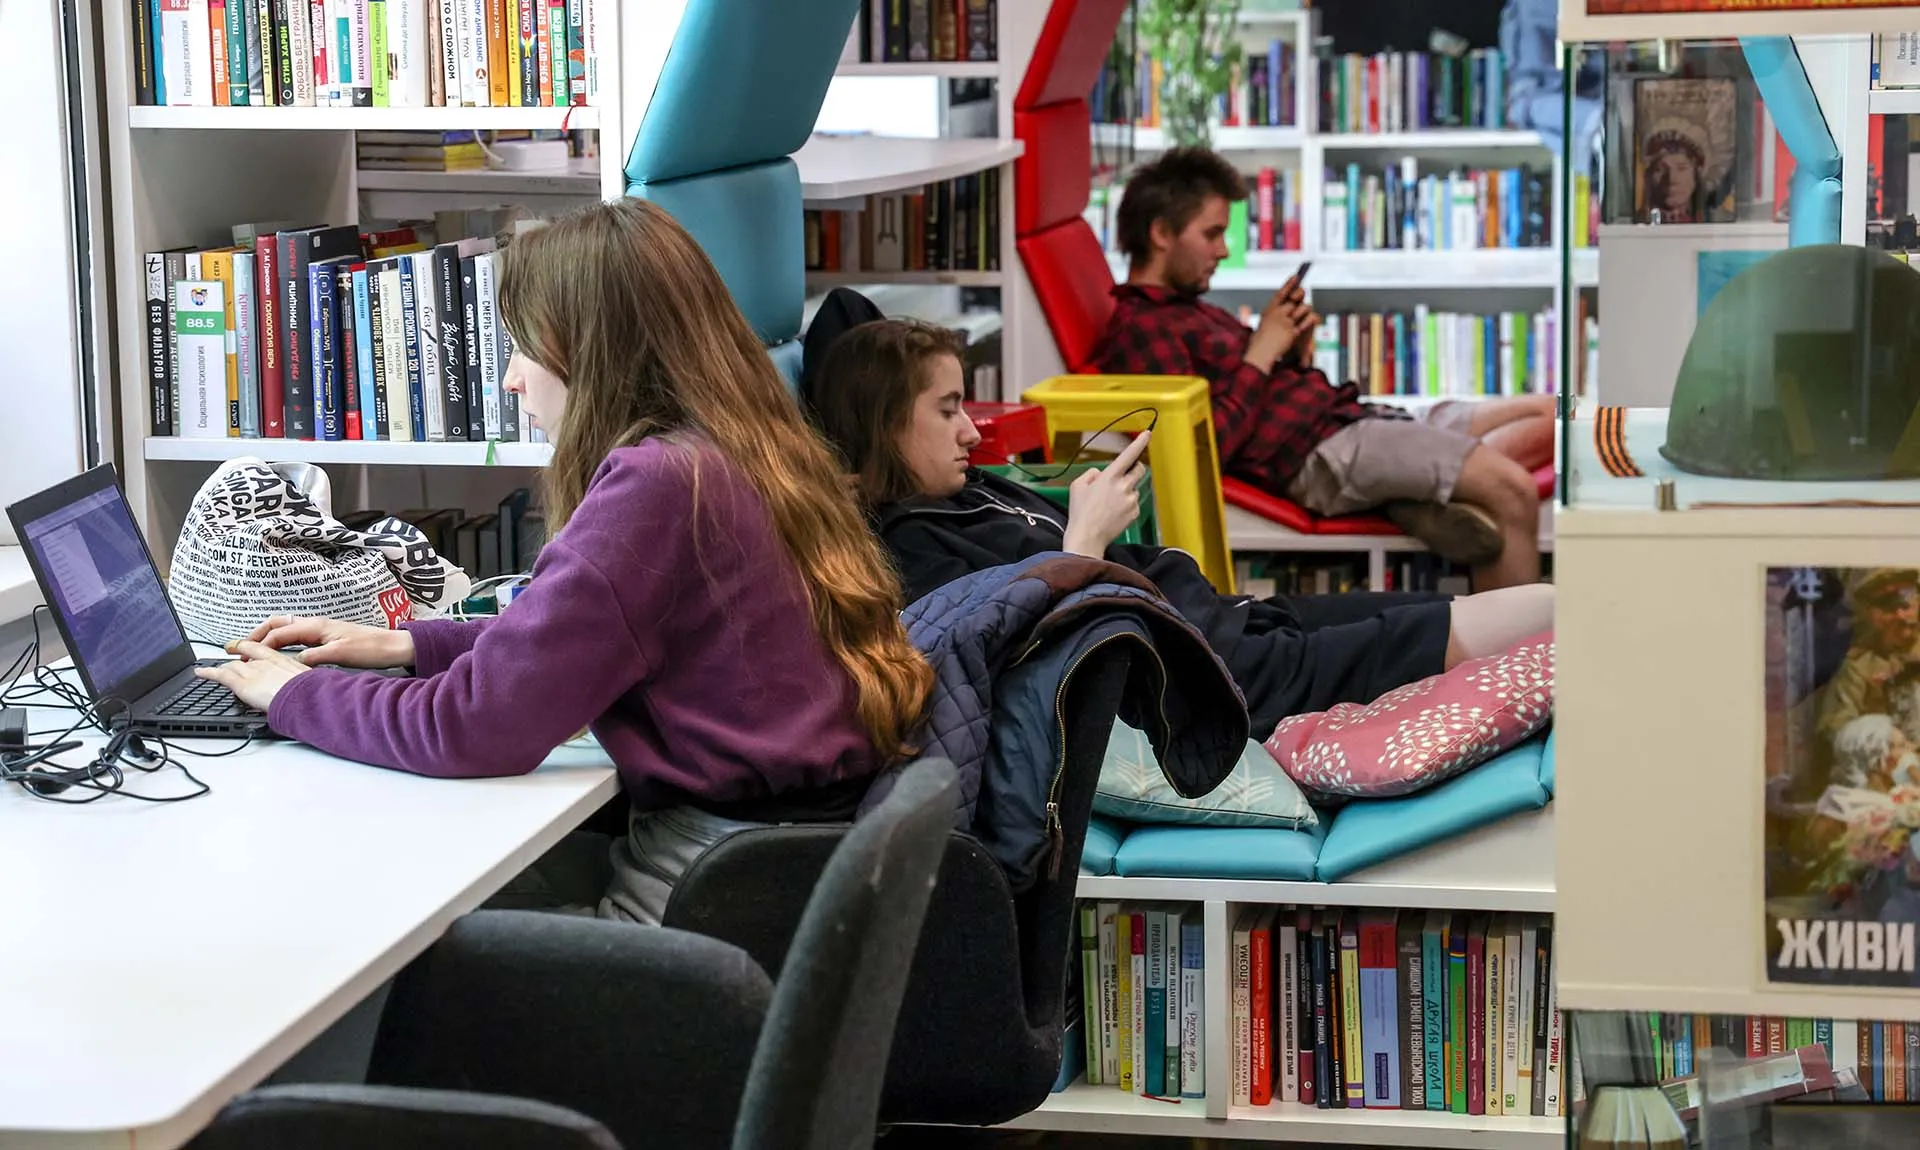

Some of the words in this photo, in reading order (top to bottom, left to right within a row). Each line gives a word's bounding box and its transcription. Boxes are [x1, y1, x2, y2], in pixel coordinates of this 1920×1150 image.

[261, 15, 270, 55] КОТОРОЙ
[475, 17, 483, 36] ДНЮ
[522, 8, 531, 32] СИЛА
[181, 20, 191, 60] психология
[280, 26, 290, 56] ХАРВИ
[294, 38, 303, 56] БЕЗ
[355, 27, 365, 81] психология
[401, 39, 409, 70] Симона
[446, 27, 455, 80] СЛОЖНОМ
[262, 58, 270, 76] НЕТ
[282, 57, 291, 84] СТИВ
[296, 59, 306, 99] ЛЮБОВЬ
[443, 258, 451, 280] МАРИЯ
[288, 280, 298, 329] ПРИНЦИПЫ
[402, 280, 413, 308] РЕШИЛ
[151, 305, 163, 325] БЕЗ
[186, 317, 215, 329] 88.5
[265, 300, 273, 348] ПСИХОЛОГИЯ
[373, 307, 383, 340] ЗВОНИТЬ
[404, 309, 416, 346] ПРОЖИТЬ
[423, 305, 436, 328] без
[466, 303, 475, 332] ИДЕЮ
[482, 300, 492, 329] СМЕРТЬ
[153, 327, 164, 379] ФИЛЬТРОВ
[290, 330, 299, 361] ДАЛИО
[375, 340, 384, 357] МНЕ
[425, 343, 439, 377] обид
[467, 332, 479, 366] ПОДАЙ
[484, 332, 494, 383] ЭКСПЕРТИЗЫ
[502, 333, 511, 359] ПРОС
[196, 345, 207, 386] психология
[376, 358, 385, 387] ХВАТИТ
[408, 358, 419, 371] 120
[197, 387, 209, 428] Социальная
[230, 551, 244, 565] ST.
[245, 569, 278, 579] MOSCOW
[281, 563, 327, 577] SHANGHAI
[242, 580, 261, 588] HONG
[283, 575, 320, 588] BANGKOK
[259, 589, 300, 597] PETERSBURG
[301, 586, 323, 595] TOKYO
[324, 583, 340, 592] NEW
[299, 594, 330, 602] FRANCISCO
[331, 590, 353, 599] MANILA
[1150, 923, 1161, 986] ПРЕПОДАВАТЕЛЬ
[1169, 945, 1177, 976] ИСТОРИЯ
[1778, 918, 1915, 972] ЖИВИ
[1240, 944, 1248, 989] НЕПОЭМА
[1409, 957, 1422, 996] СЛИШКОМ
[1103, 979, 1111, 1021] испортить
[1111, 990, 1119, 1021] первые
[1134, 974, 1142, 1017] МНОГОДЕТНОЙ
[1169, 978, 1177, 1020] ПЕДАГОГИКИ
[1316, 983, 1324, 1006] УМНАЯ
[1410, 997, 1422, 1022] ТЕМНО
[1104, 1022, 1110, 1033] не
[1426, 998, 1440, 1044] ДРУГАЯ
[1410, 1032, 1424, 1084] НЕВЫНОСИМО
[1550, 1036, 1560, 1064] ТИРАН!
[1428, 1050, 1442, 1090] ШКОЛА
[1411, 1086, 1425, 1105] ТИХО
